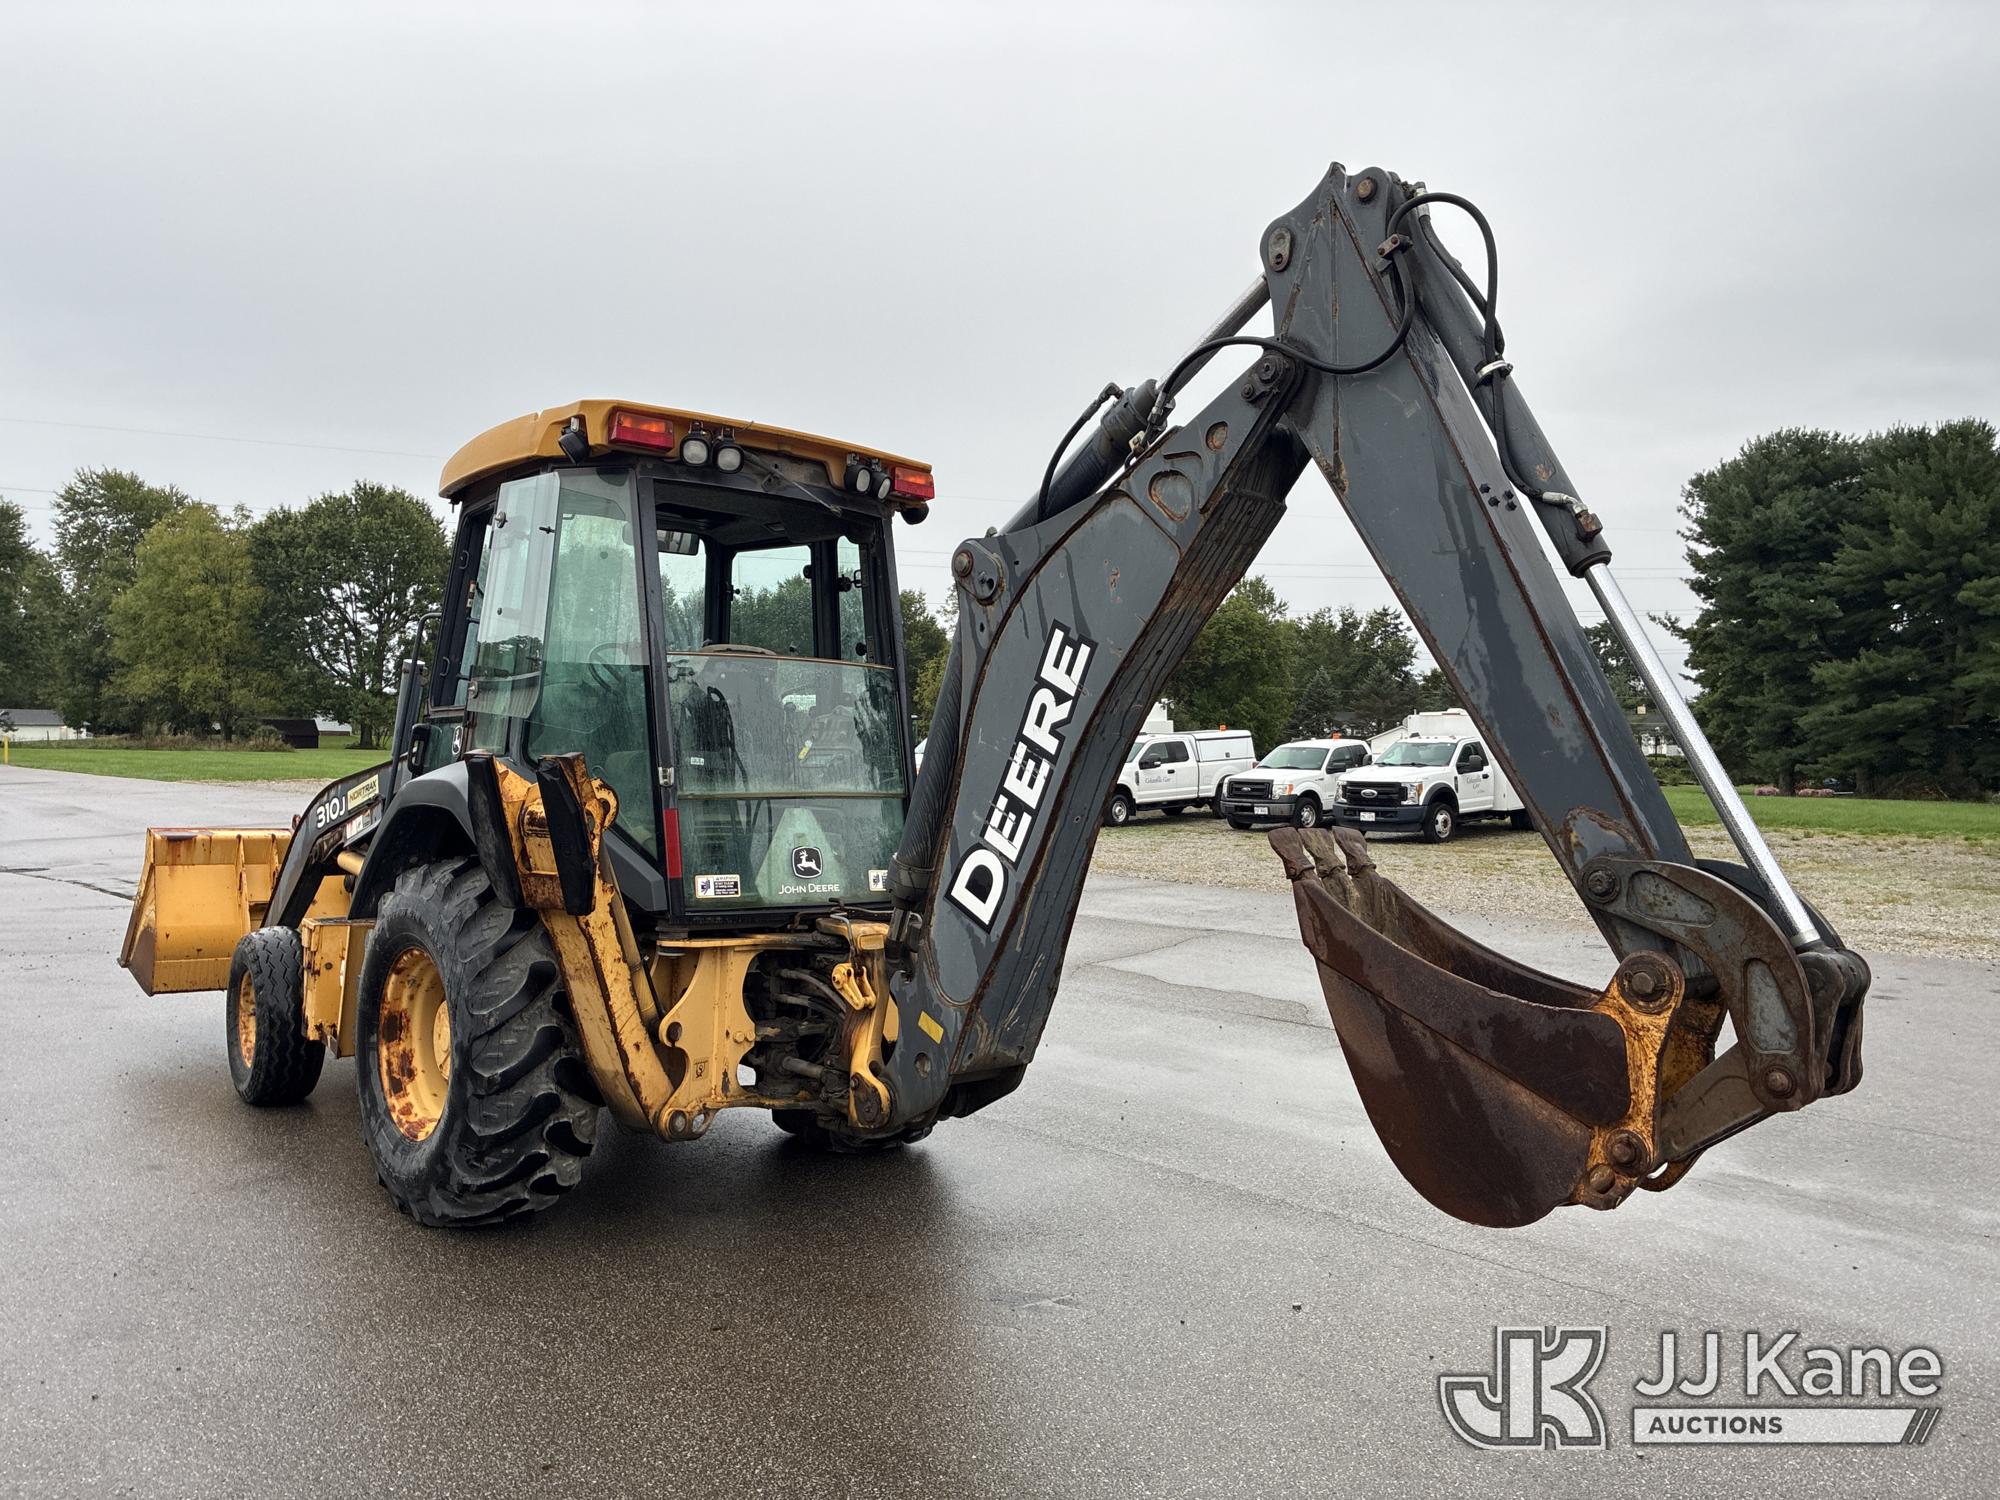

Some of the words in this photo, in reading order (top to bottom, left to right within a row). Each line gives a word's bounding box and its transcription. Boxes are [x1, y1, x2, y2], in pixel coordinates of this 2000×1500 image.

[949, 626, 1092, 927] DEERE
[350, 779, 377, 802] NORTRAX
[317, 796, 346, 828] 310J
[778, 884, 807, 895] JOHN
[808, 883, 841, 893] DEERE
